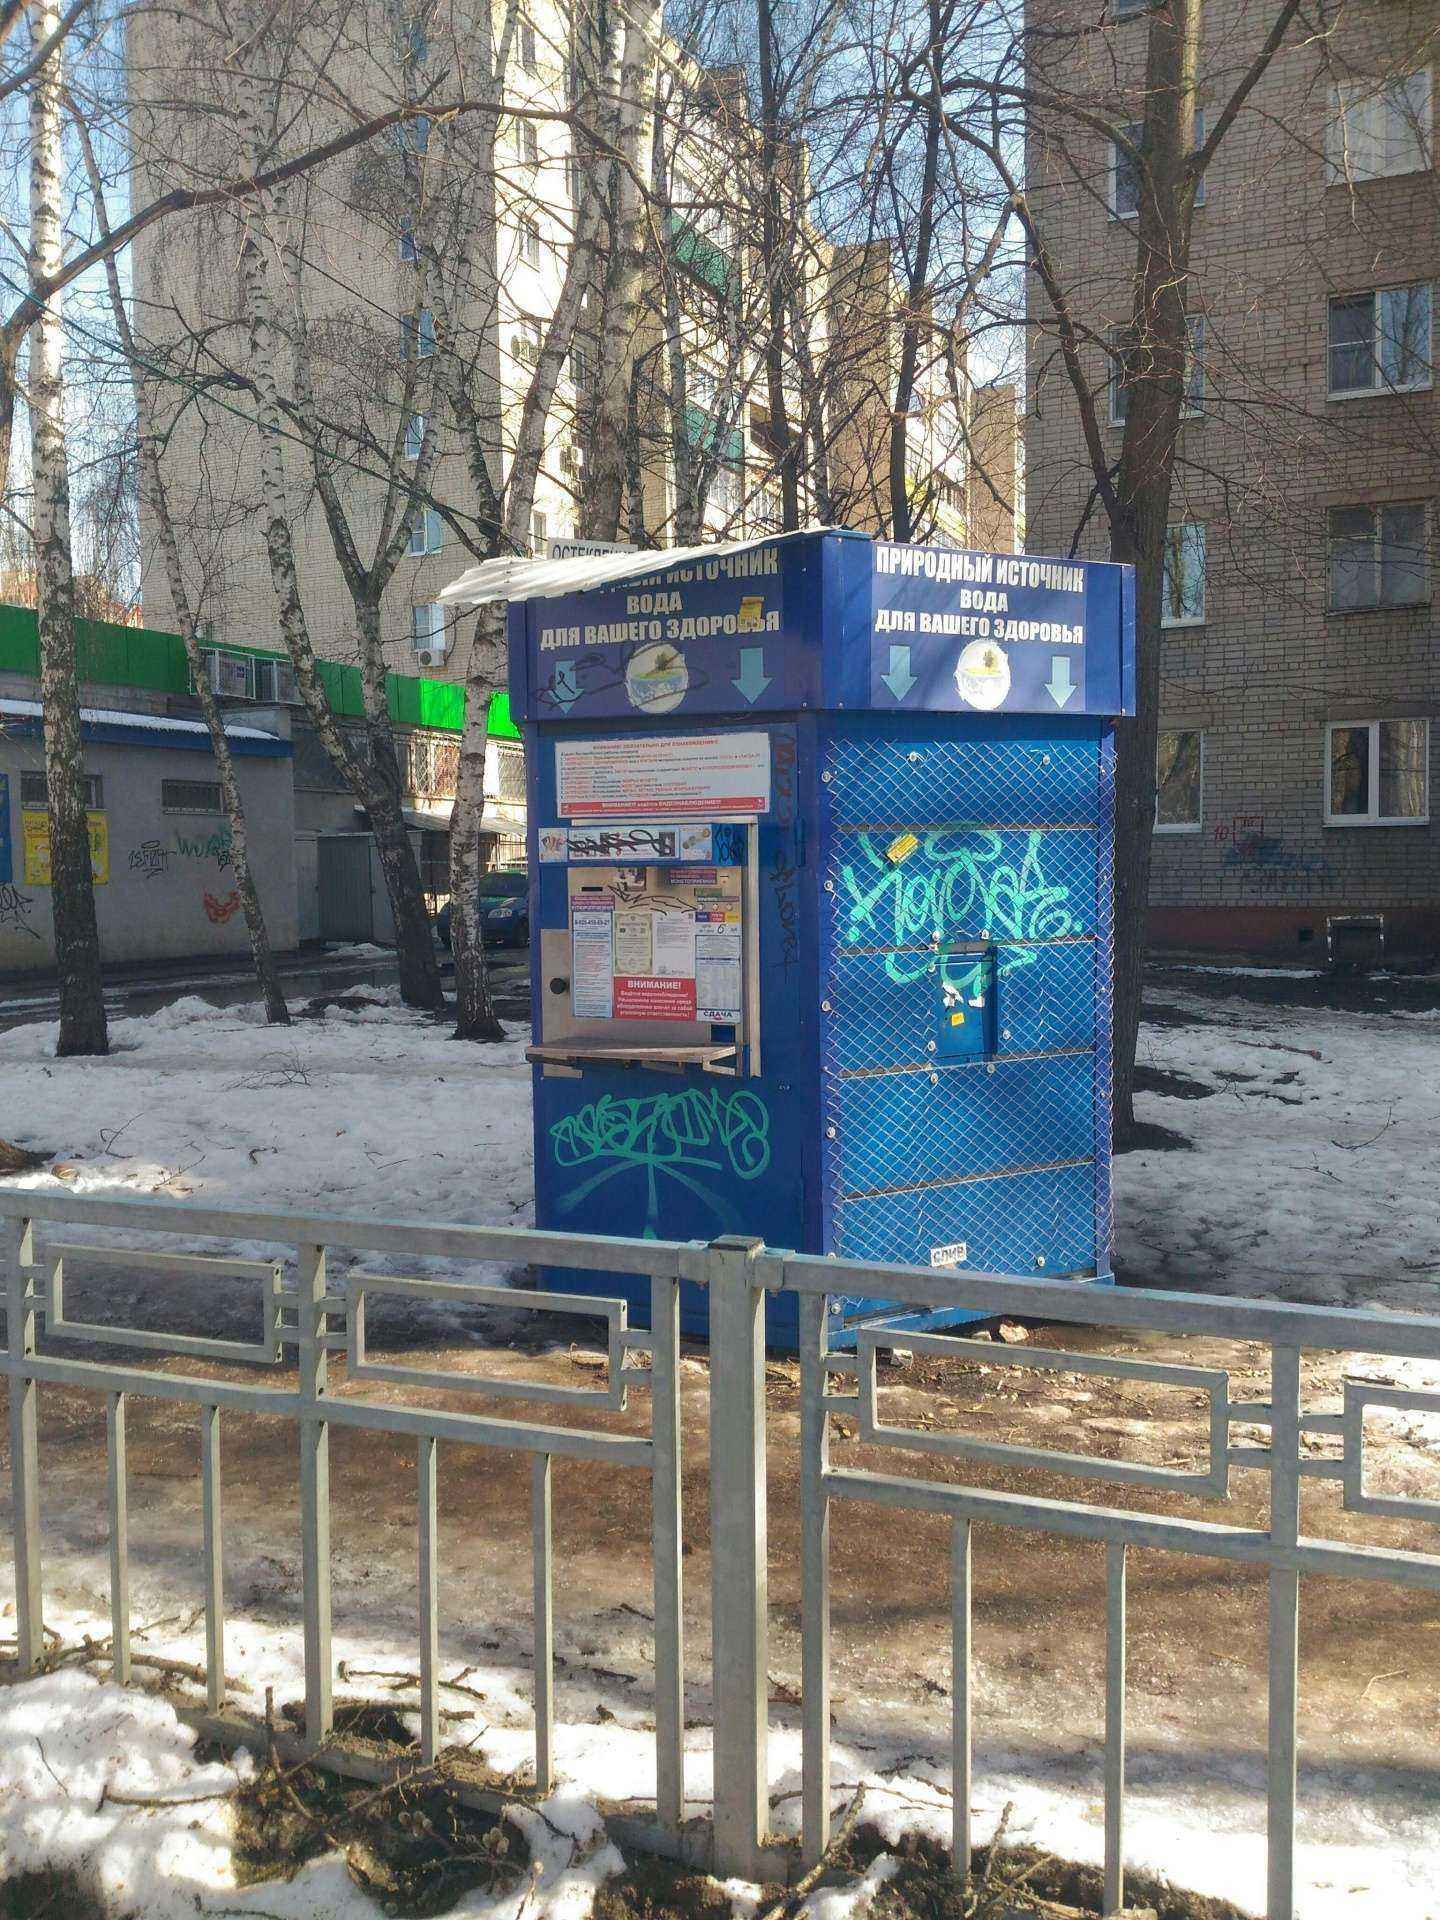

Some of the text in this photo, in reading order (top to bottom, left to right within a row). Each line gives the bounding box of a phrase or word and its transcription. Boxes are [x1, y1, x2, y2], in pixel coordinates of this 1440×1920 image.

[876, 546, 1084, 592] ПРИРОДНЫЙ ИСТОЧНИК
[626, 591, 683, 616] ВОДА
[960, 589, 1009, 613] ВОДА
[540, 627, 580, 651] ДЛЯ
[584, 620, 662, 645] ВАШЕГО
[874, 609, 1084, 644] ДЛЯ ВАШЕГО ЗДОРОВЬЯ
[627, 979, 682, 990] ВНИМАНИЕ!
[703, 1010, 733, 1018] СДАЧА
